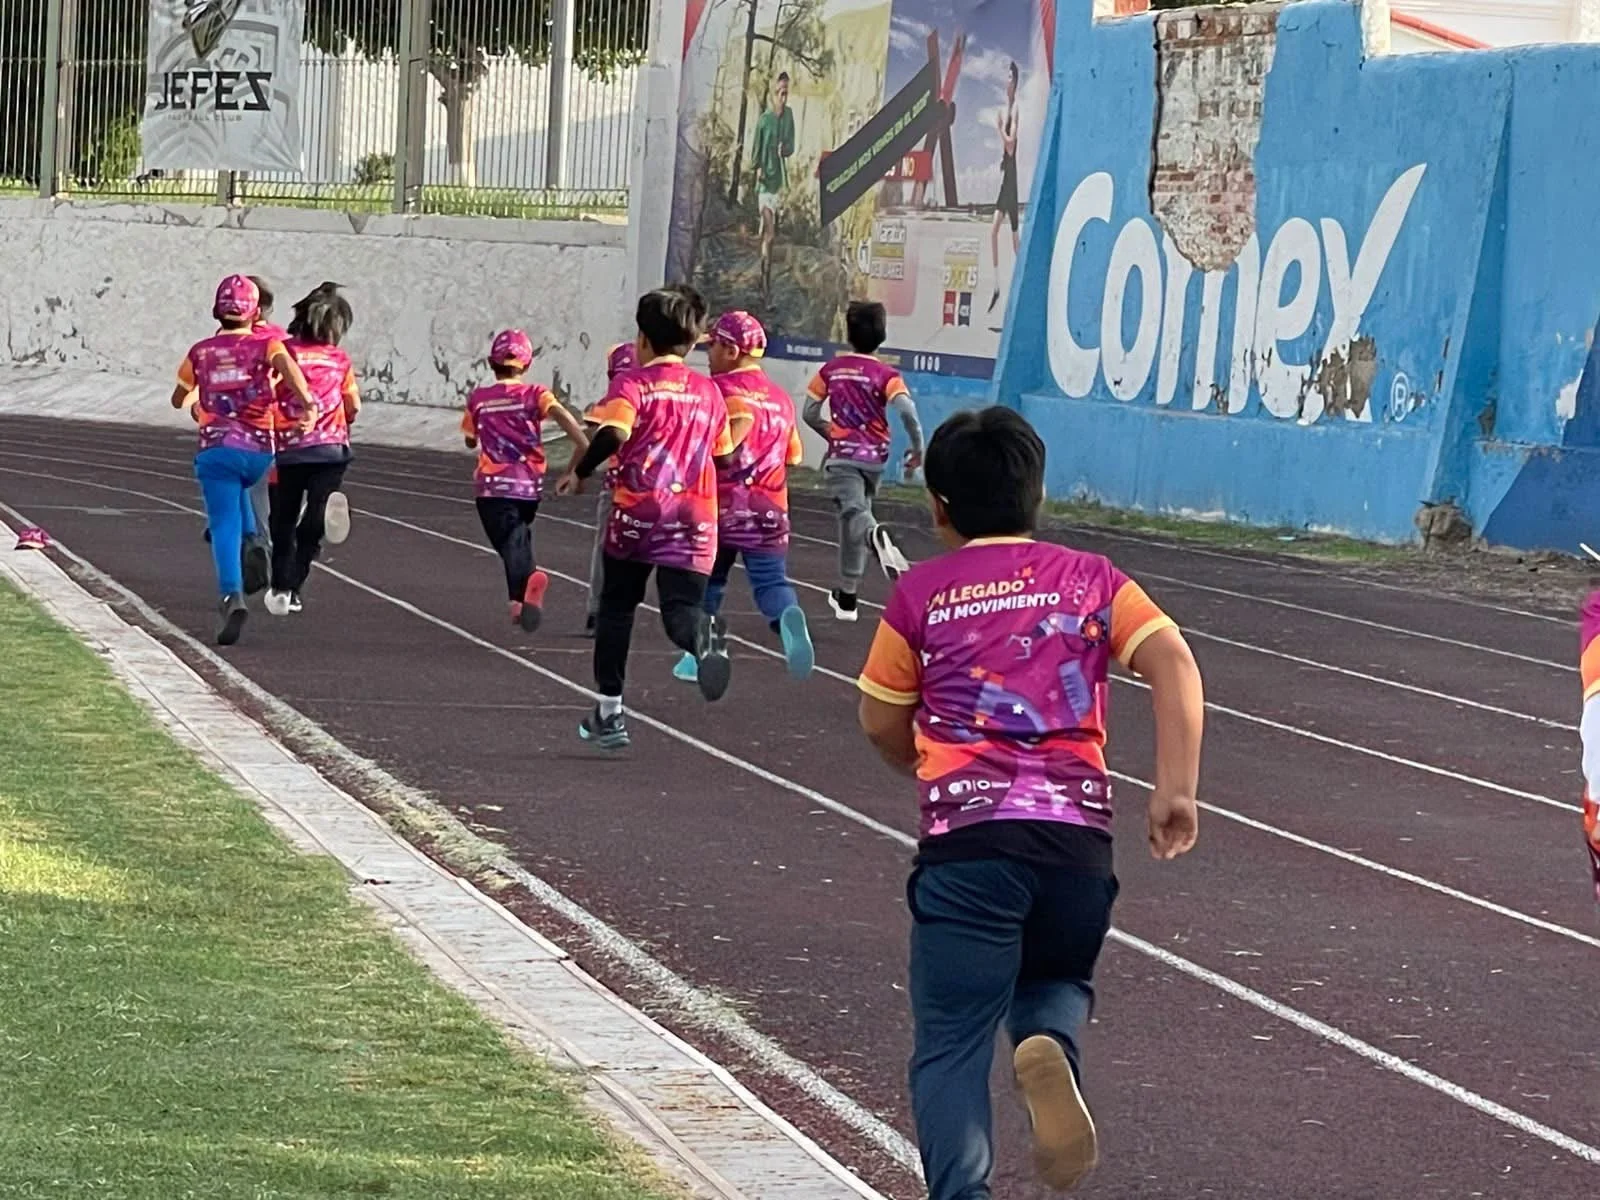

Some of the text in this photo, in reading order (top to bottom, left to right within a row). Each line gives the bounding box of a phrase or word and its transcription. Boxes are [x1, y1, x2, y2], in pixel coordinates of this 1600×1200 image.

[950, 580, 1025, 604] LEGADO
[927, 592, 1061, 625] EN MOVIMIENTO
